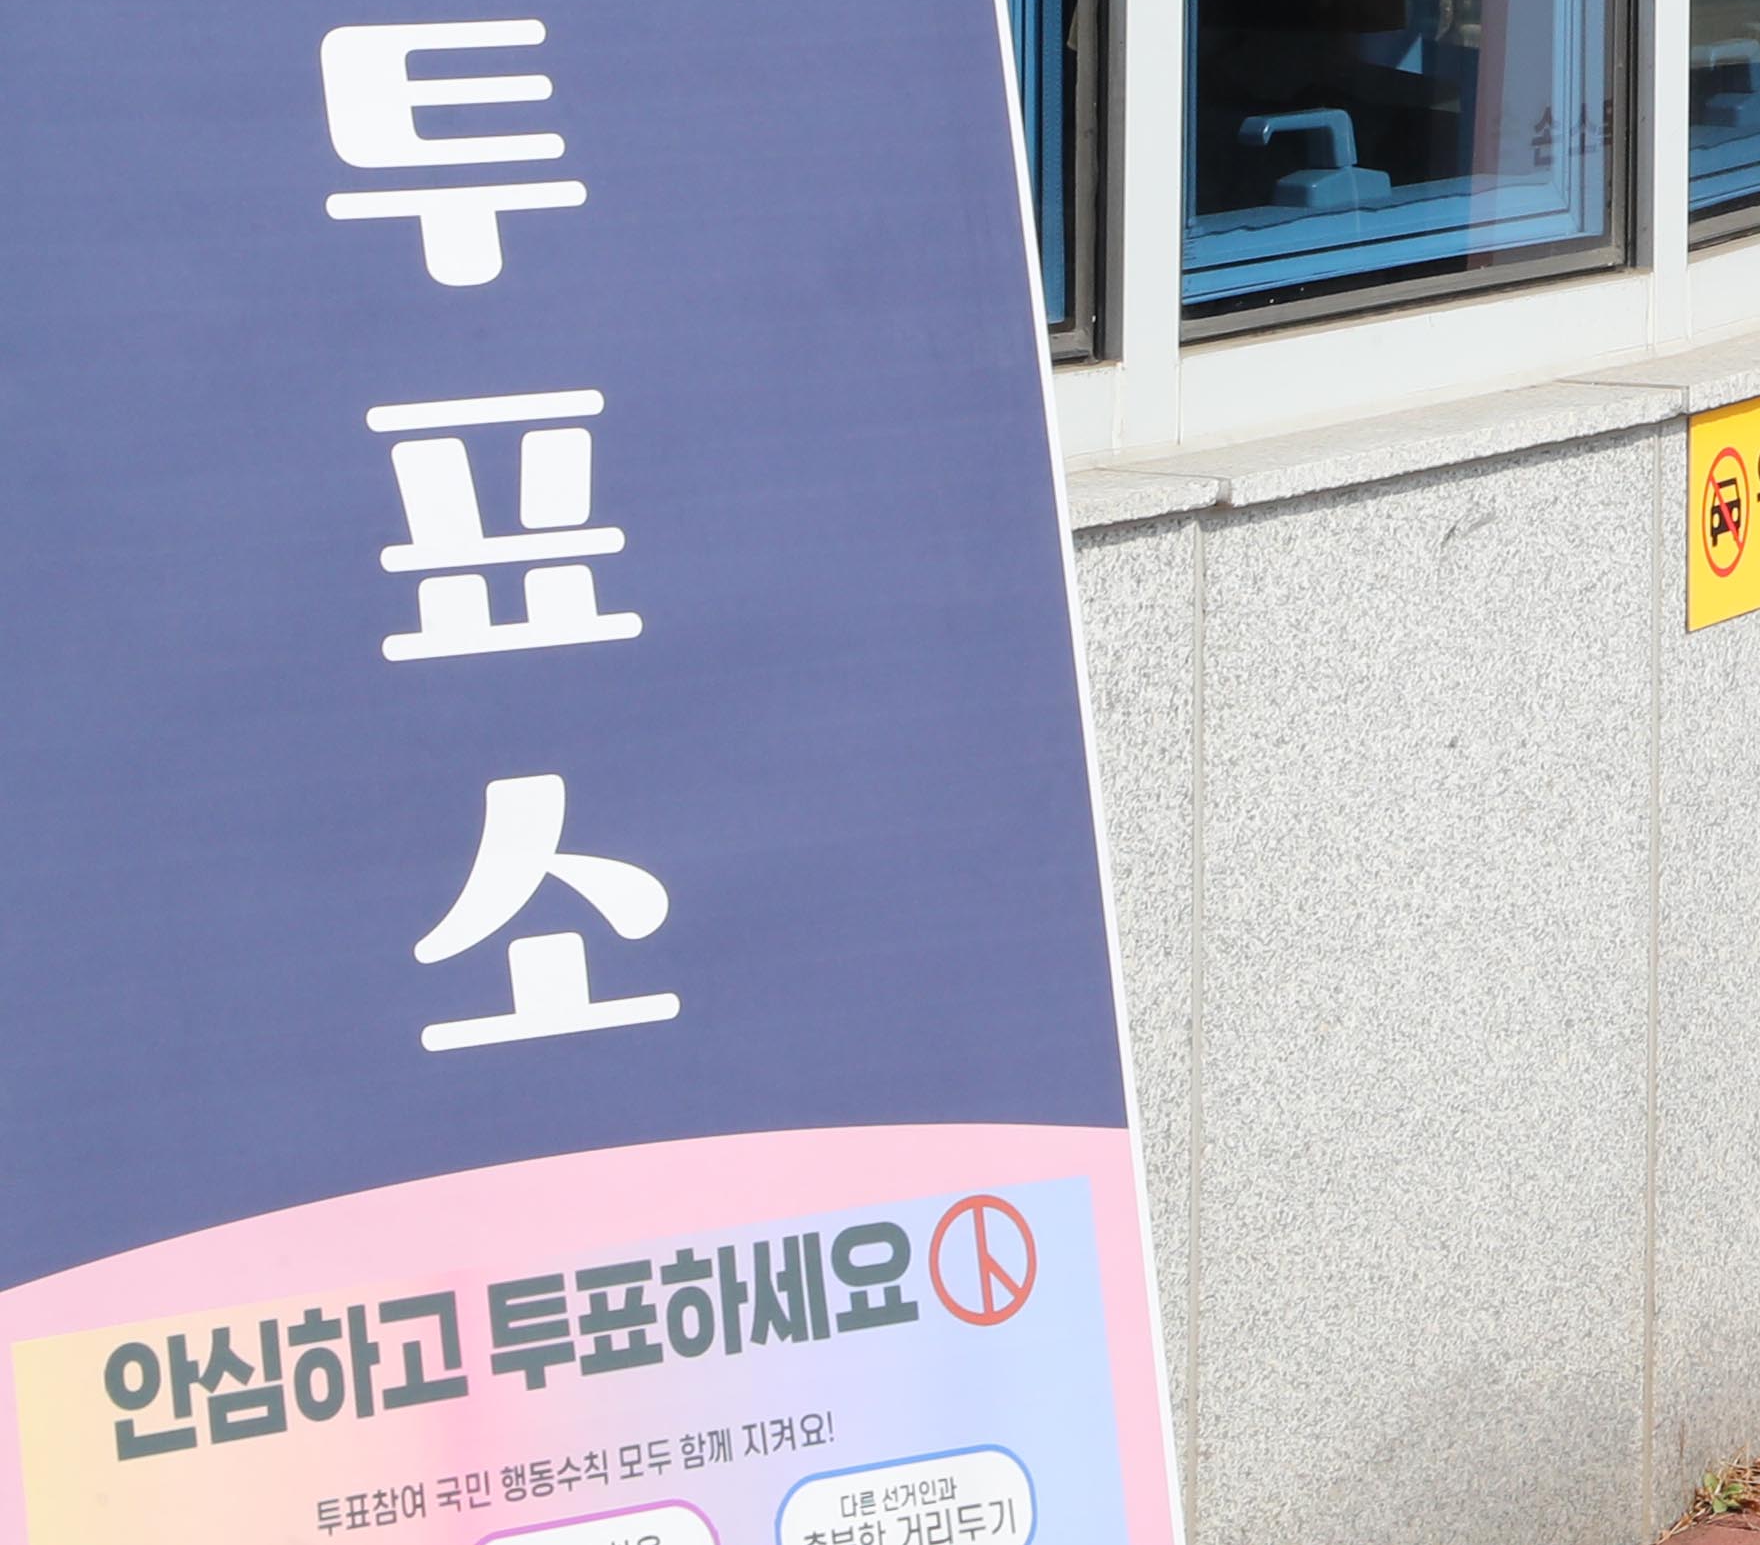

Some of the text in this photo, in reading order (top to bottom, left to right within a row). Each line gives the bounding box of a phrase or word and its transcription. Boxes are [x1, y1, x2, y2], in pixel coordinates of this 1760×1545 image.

[320, 18, 680, 1052] 투표소
[103, 1220, 919, 1462] 안심하고 투표하세요
[316, 1411, 835, 1537] 투표참여 국민 행동수칙 모두 함께 지켜요!
[840, 1476, 958, 1518] 다른 선거인과
[897, 1498, 1017, 1545] 거리두기
